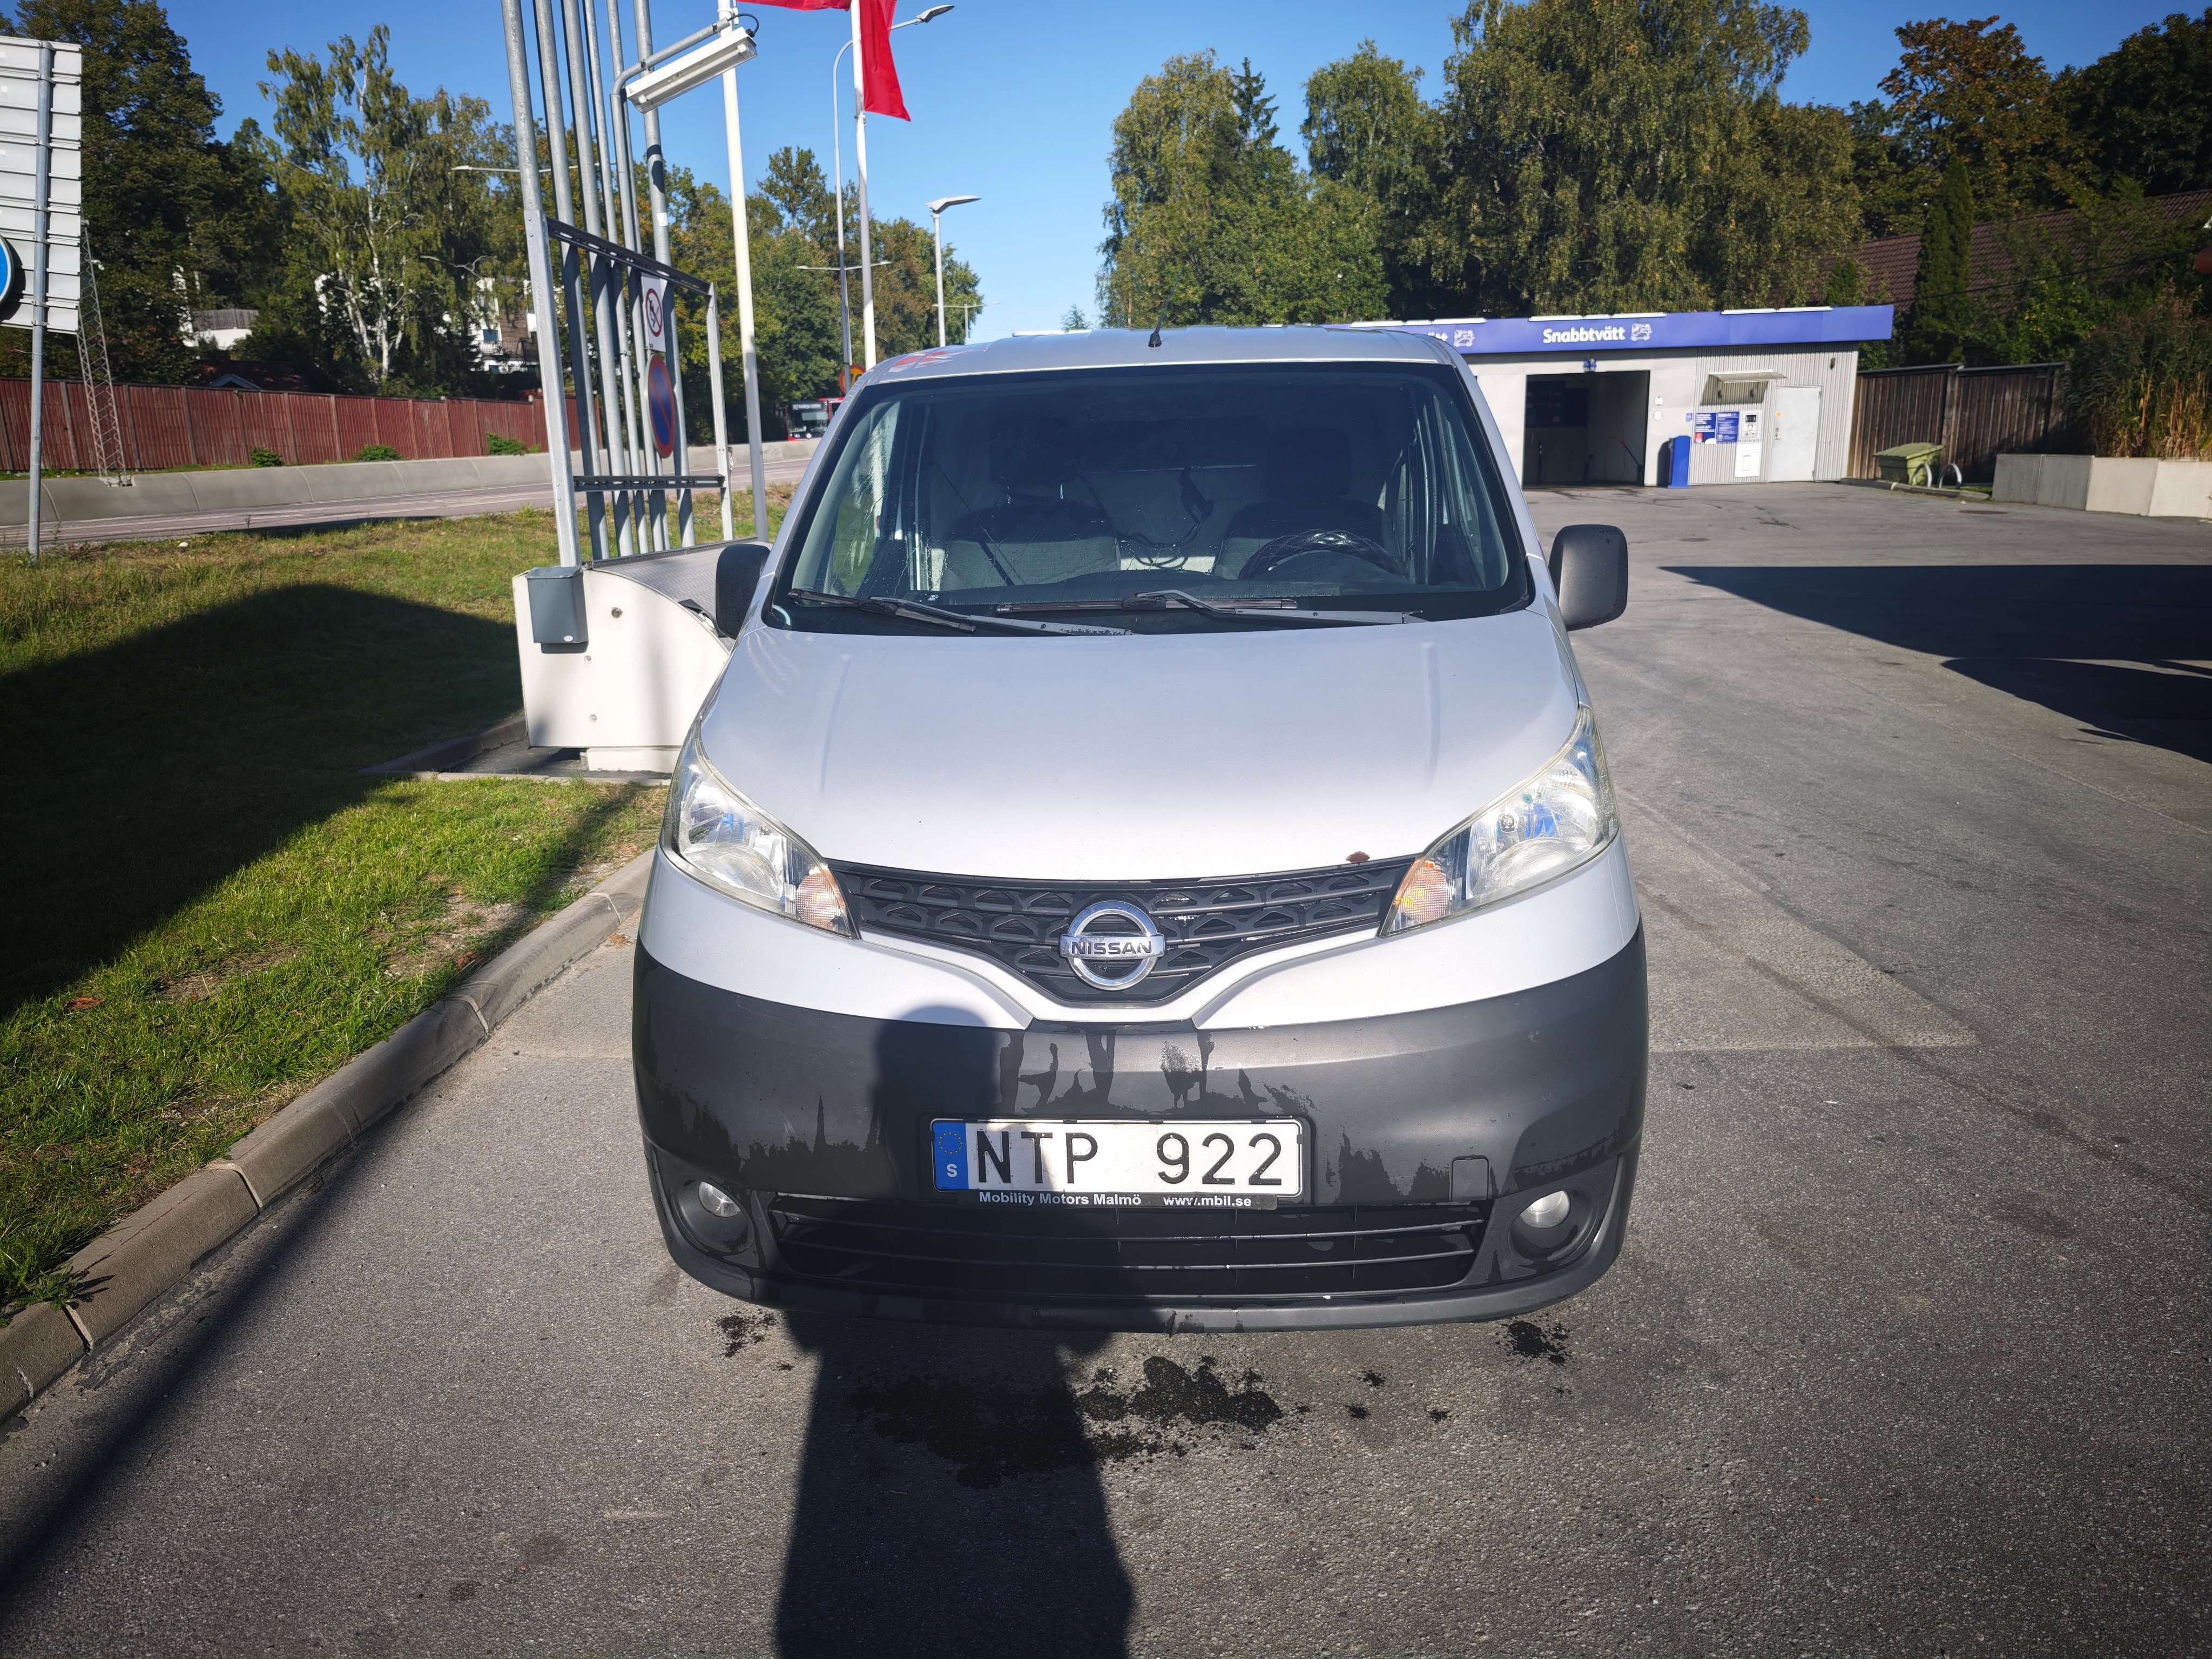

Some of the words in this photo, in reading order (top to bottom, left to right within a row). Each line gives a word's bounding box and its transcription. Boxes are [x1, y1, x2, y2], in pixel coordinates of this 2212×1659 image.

[1543, 326, 1626, 343] Snabbtvätt
[1071, 941, 1152, 955] NISSAN
[976, 1130, 1098, 1184] NTP
[1157, 1132, 1282, 1185] 922
[946, 1163, 957, 1177] S
[979, 1191, 1035, 1206] Mobility
[1040, 1193, 1089, 1205] Motors
[1094, 1193, 1141, 1205] Malmö
[1163, 1195, 1252, 1206] www.mbil.se
